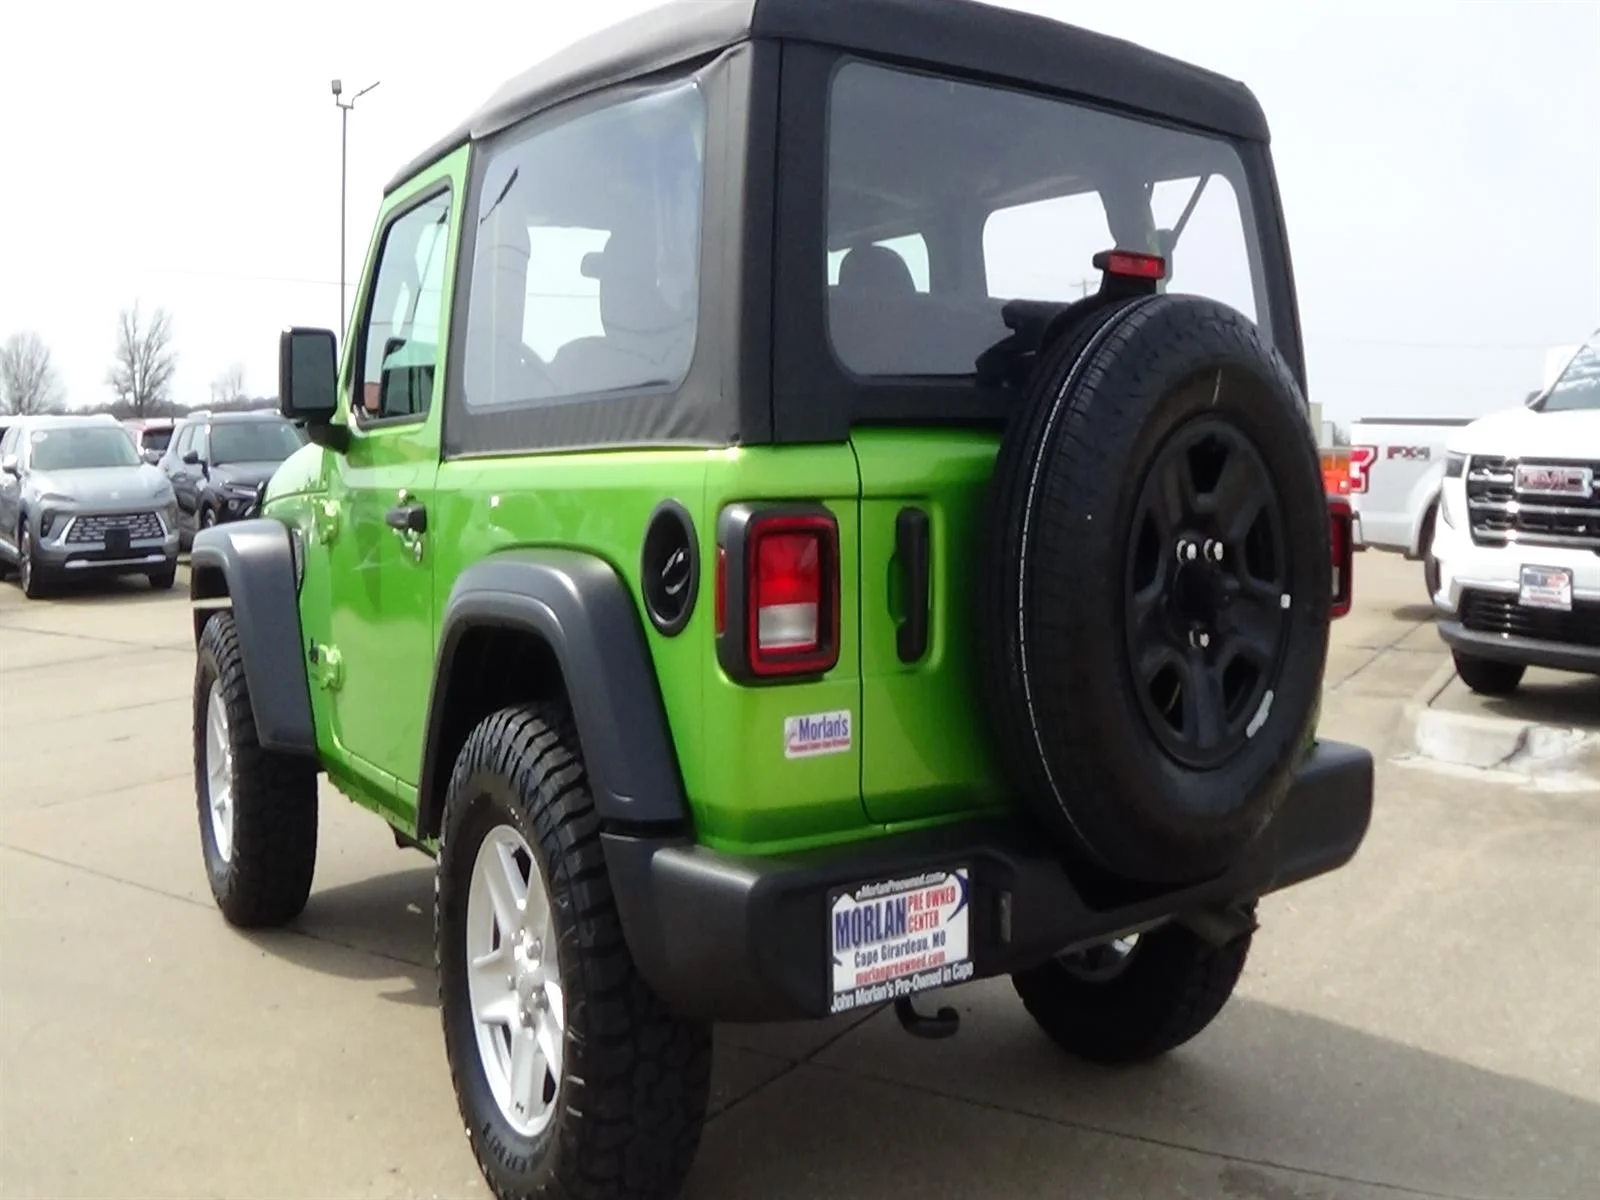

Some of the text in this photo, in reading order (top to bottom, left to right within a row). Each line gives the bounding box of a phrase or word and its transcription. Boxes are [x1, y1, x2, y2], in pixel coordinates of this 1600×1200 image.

[1387, 445, 1430, 460] FX4
[799, 714, 849, 741] Morlan's
[908, 886, 956, 913] PRE OWNED
[835, 897, 906, 953] MORLAN
[908, 910, 939, 933] CENTER
[855, 950, 878, 968] Cape
[932, 929, 946, 947] MO
[831, 992, 854, 1013] John
[855, 981, 894, 1006] Morlan's
[895, 966, 942, 995] Pre-Owned
[952, 960, 974, 980] Cape
